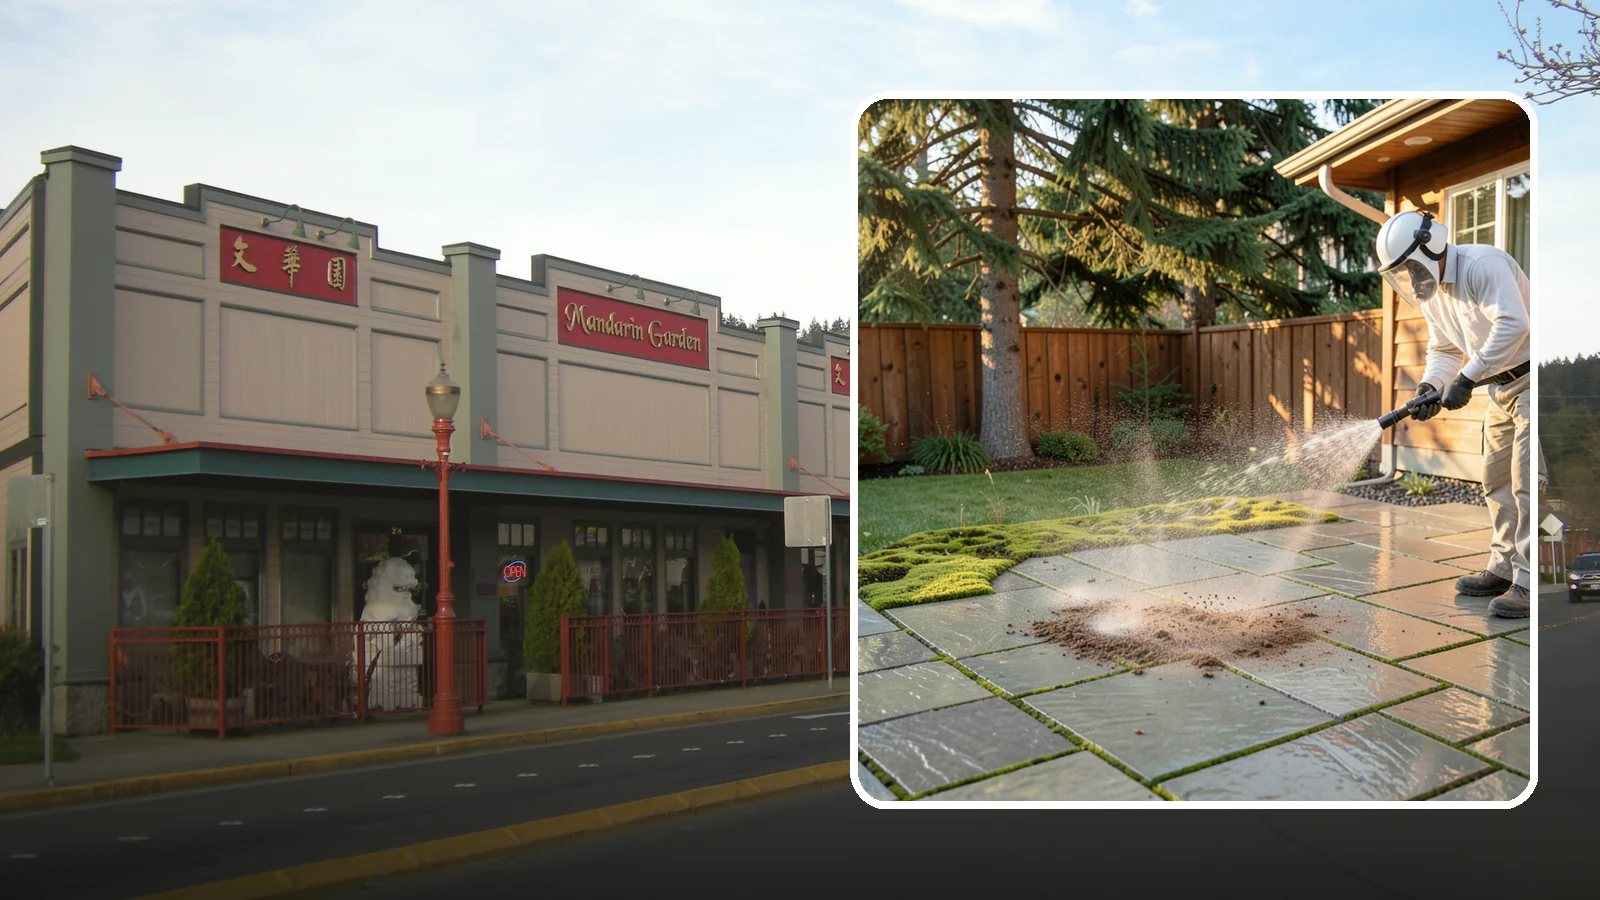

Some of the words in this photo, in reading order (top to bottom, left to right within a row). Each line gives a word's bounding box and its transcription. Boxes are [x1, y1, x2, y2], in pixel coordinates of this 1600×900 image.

[564, 302, 644, 341] Mandarin
[647, 320, 702, 352] Garden
[834, 363, 846, 386] 文
[503, 565, 527, 578] OPEN
